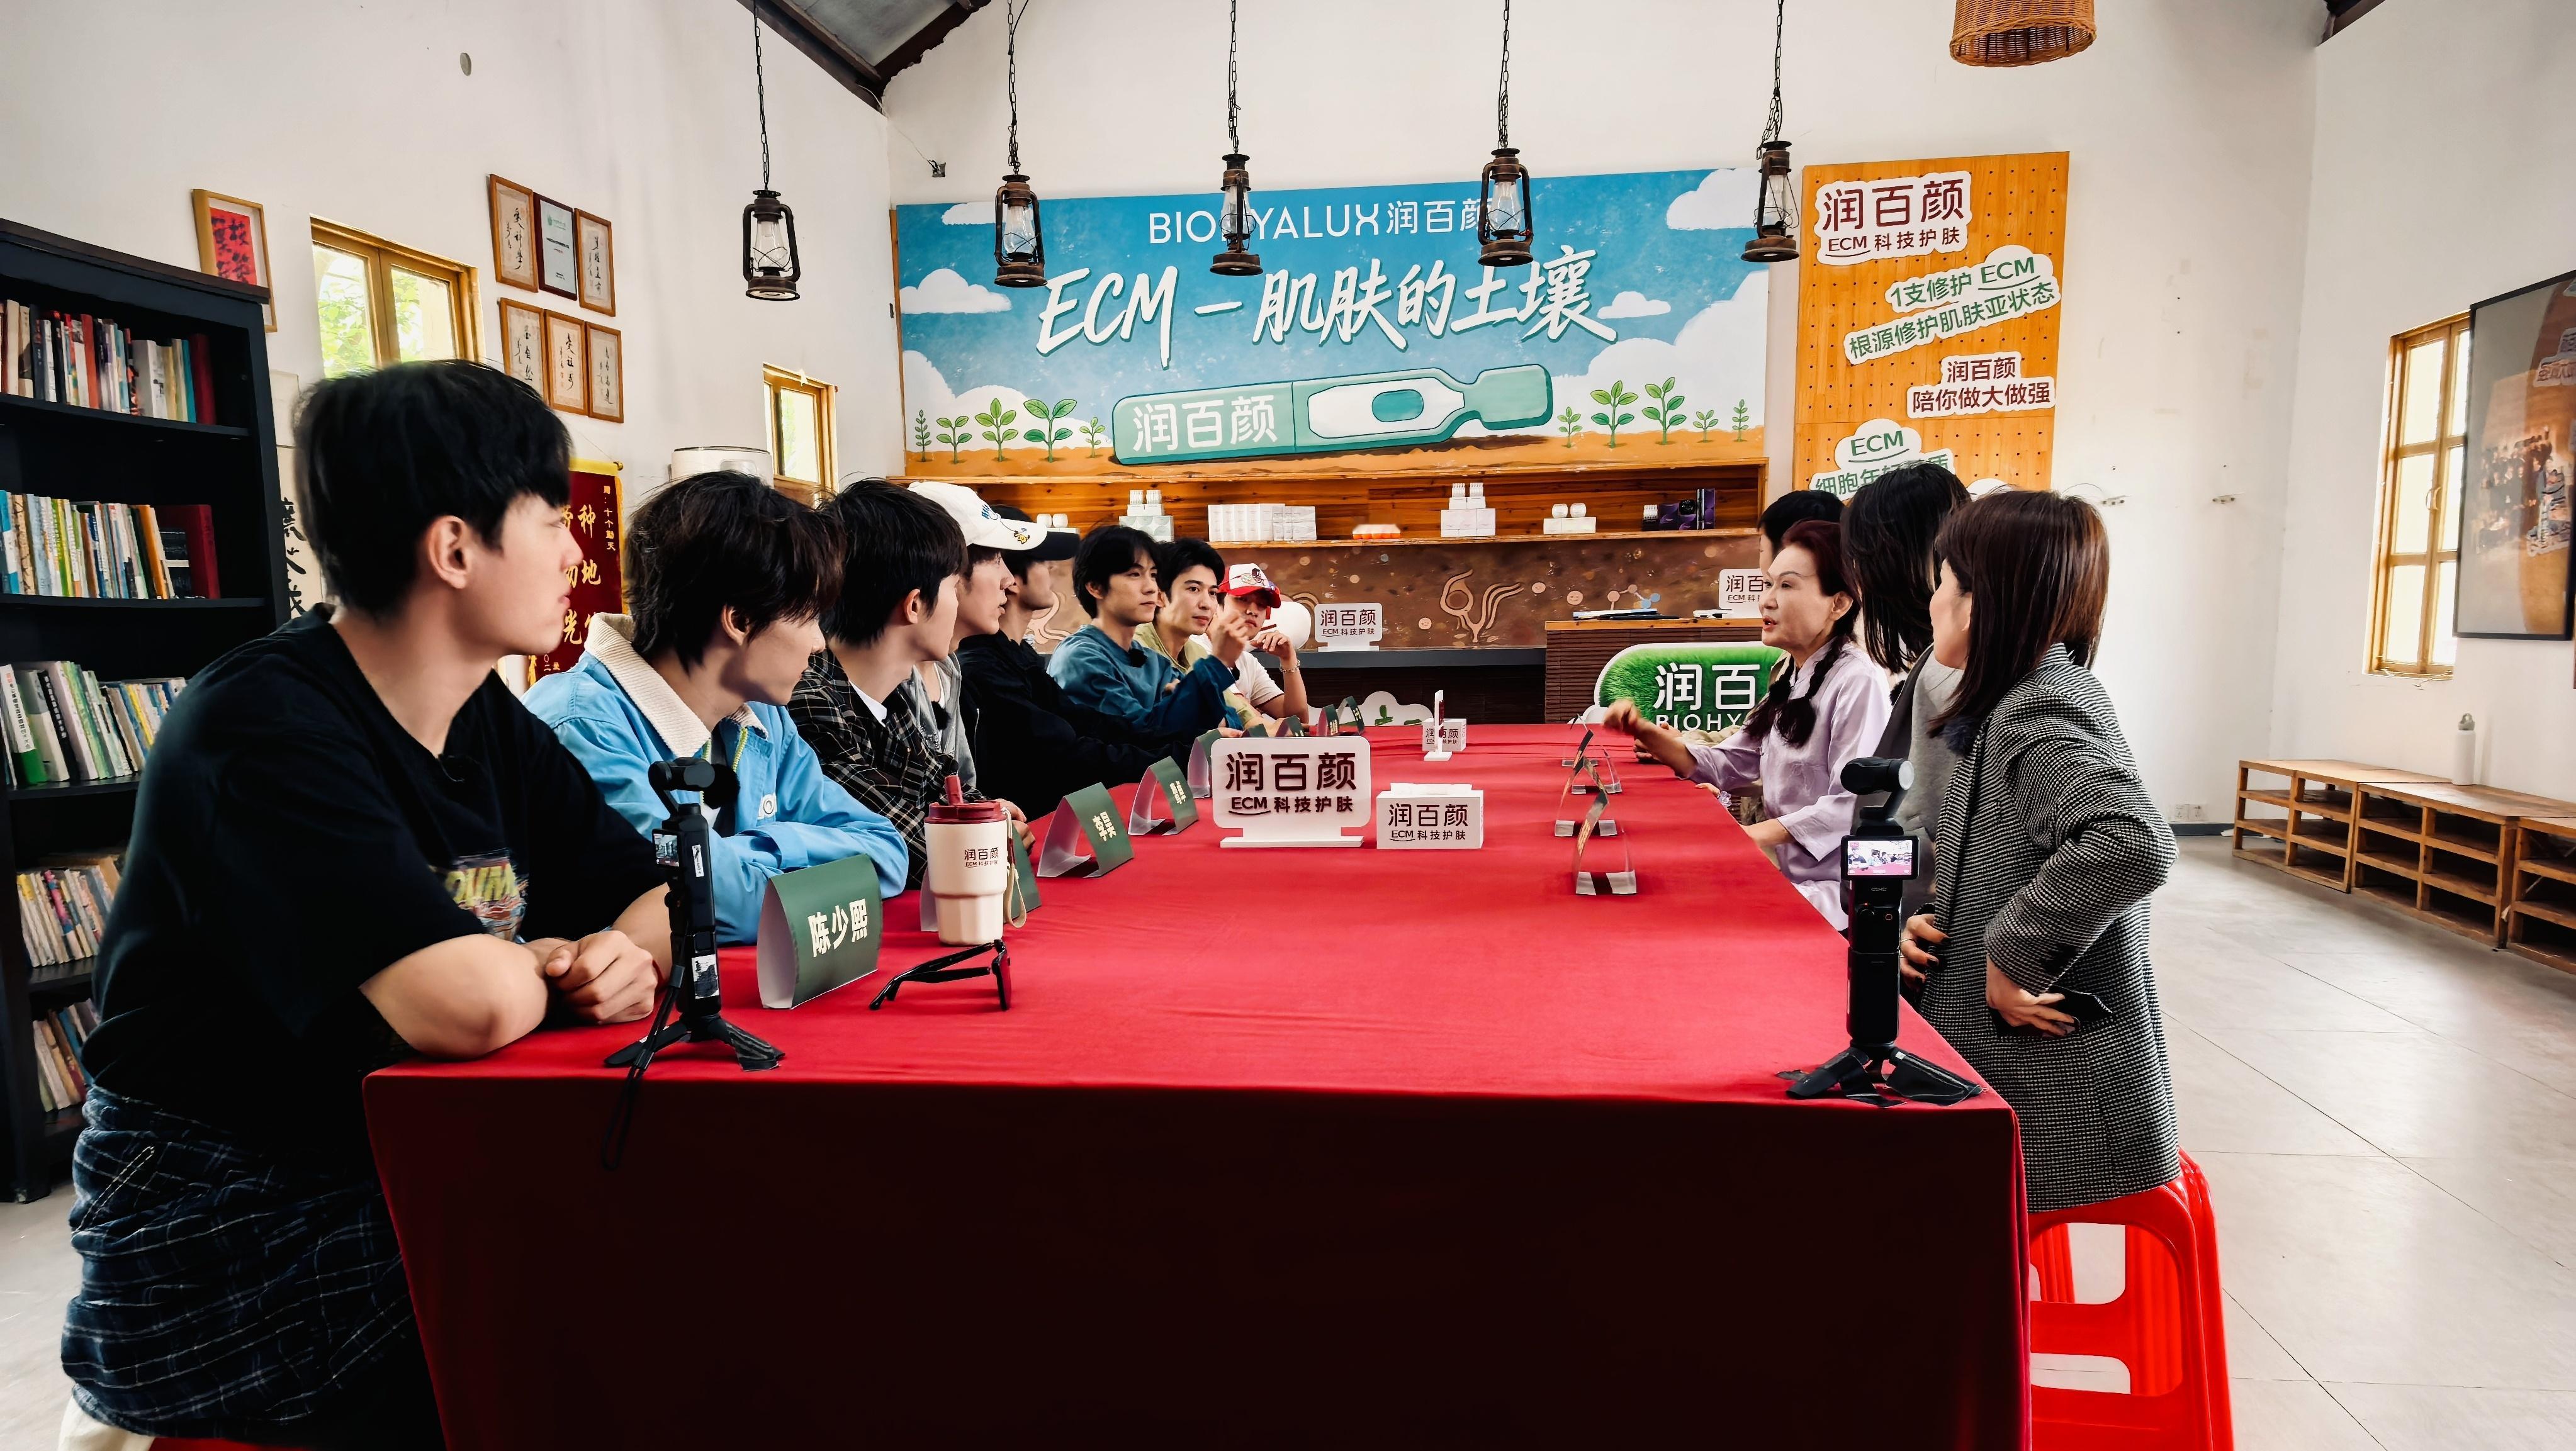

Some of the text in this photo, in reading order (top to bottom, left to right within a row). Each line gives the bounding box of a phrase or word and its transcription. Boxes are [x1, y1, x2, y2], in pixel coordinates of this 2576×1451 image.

[1149, 198, 1493, 244] BIOYALUX 润百颜
[1822, 179, 1964, 232] 润百颜
[1828, 228, 1960, 252] ECM 科技护肤
[1891, 257, 2036, 308] 1支修护 ECM
[1037, 265, 1178, 368] ECM
[1252, 245, 1617, 350] 肌肤的土壤
[1849, 281, 2055, 361] 根源修护肌肤亚状态
[1947, 357, 2016, 383] 润百颜
[1912, 381, 2051, 413] 陪你做大做强
[1132, 395, 1278, 454] 润百颜
[1850, 430, 1904, 457] ECM
[1320, 608, 1376, 627] 润百颜
[1341, 627, 1375, 636] 科技护肤
[1653, 662, 1760, 710] 润百
[1225, 751, 1357, 791] 润百颜
[1231, 796, 1353, 813] ECM 科技护肤
[1388, 803, 1468, 827] 润百颜
[1391, 830, 1466, 841] ECM 科技护肤
[964, 847, 999, 861] 润百颜
[807, 898, 868, 958] 陈少熙
